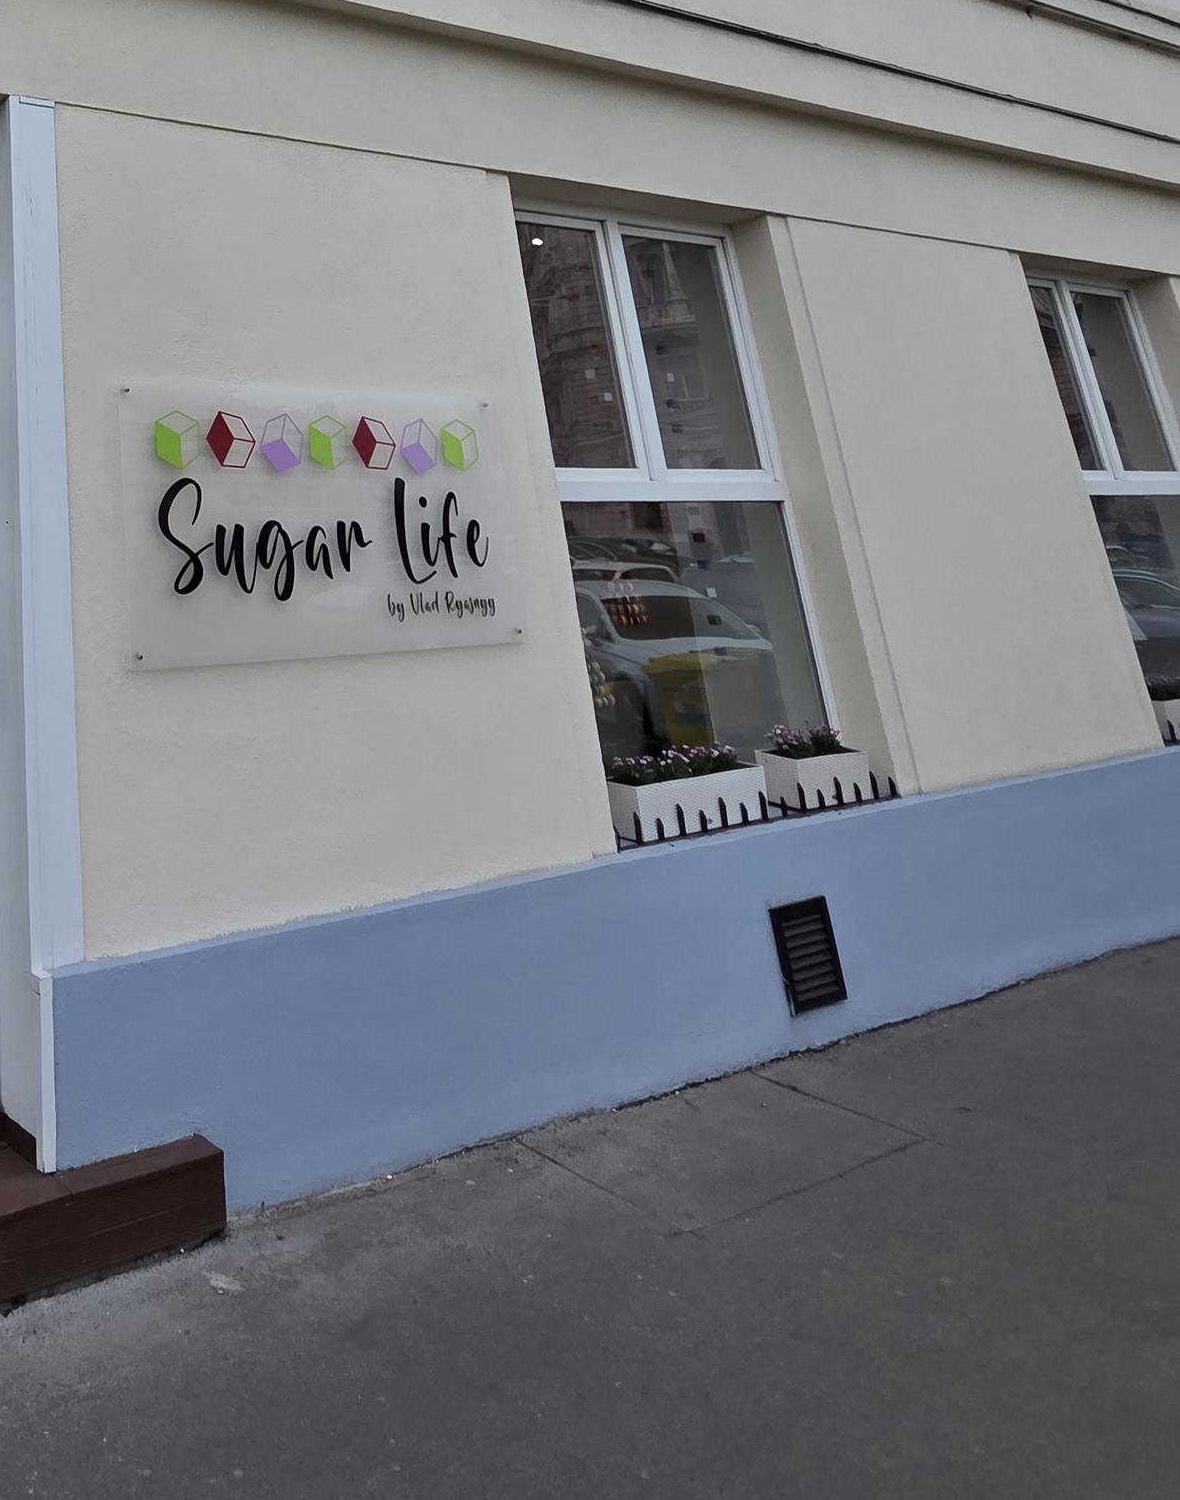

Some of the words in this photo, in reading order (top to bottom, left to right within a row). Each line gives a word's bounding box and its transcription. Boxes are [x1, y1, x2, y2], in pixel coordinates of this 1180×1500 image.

[158, 476, 372, 602] Sugar
[393, 476, 490, 585] Life
[387, 592, 405, 622] by
[410, 590, 440, 616] Vlad
